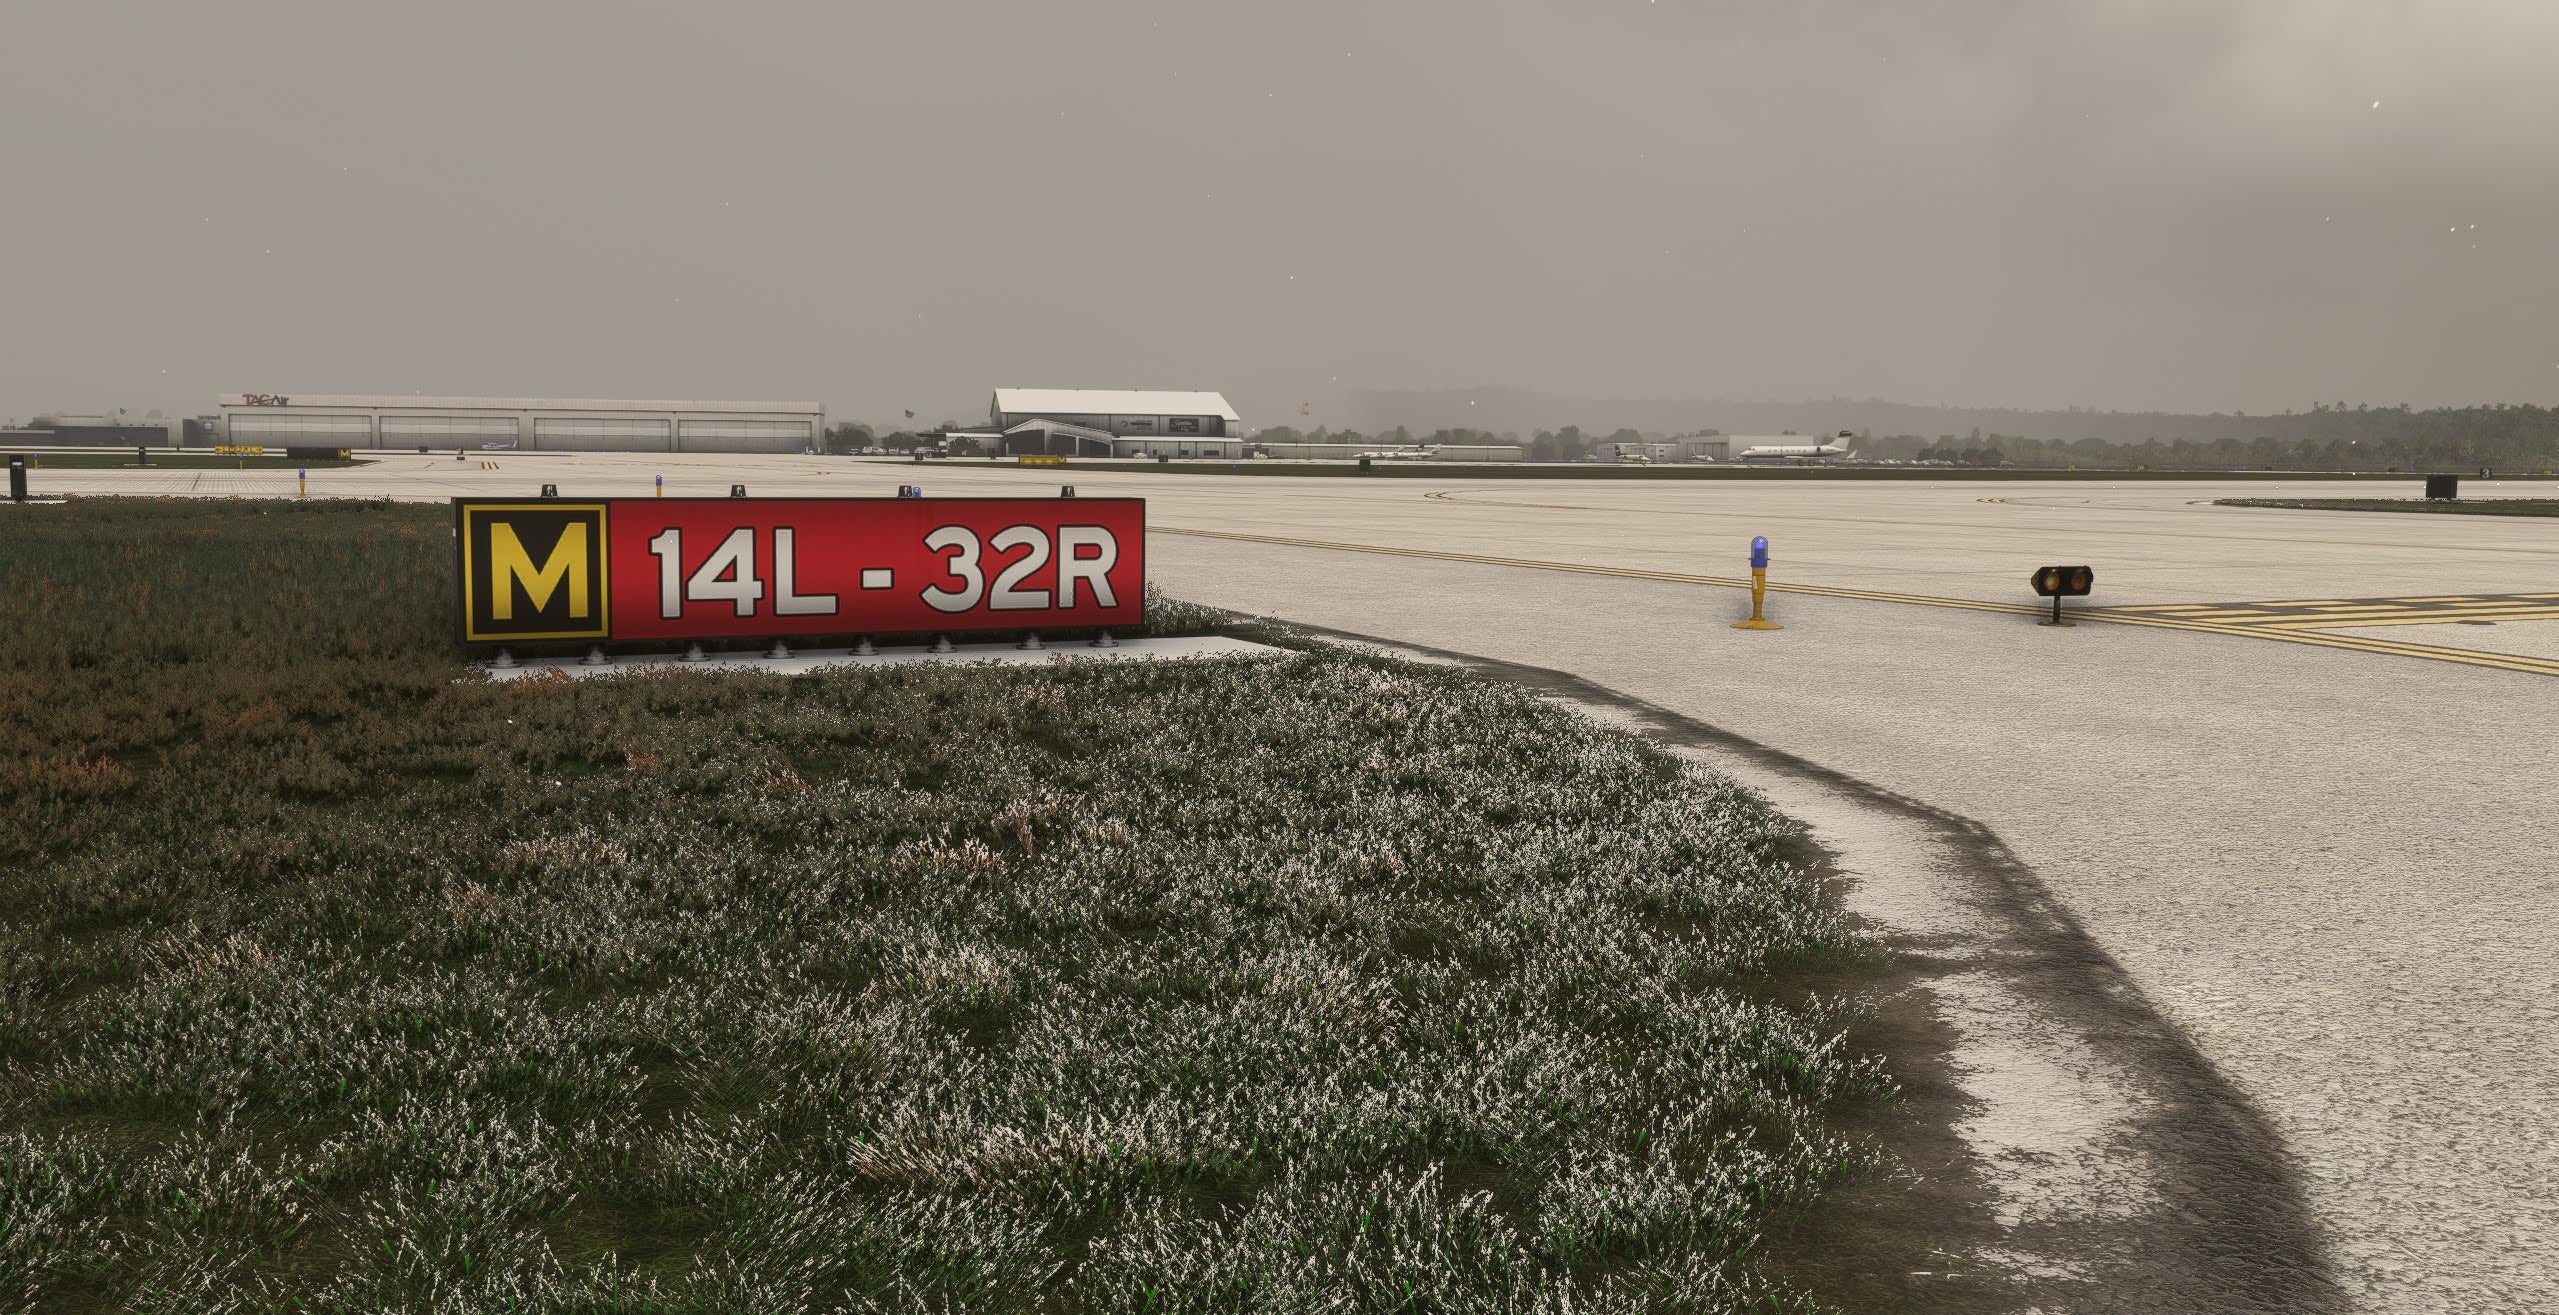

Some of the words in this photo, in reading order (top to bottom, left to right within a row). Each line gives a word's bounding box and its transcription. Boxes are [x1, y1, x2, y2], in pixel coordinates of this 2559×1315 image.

[340, 449, 349, 458] M
[2482, 468, 2490, 479] 3
[490, 522, 589, 620] M
[648, 526, 839, 620] 14L
[919, 523, 1119, 614] 32R
